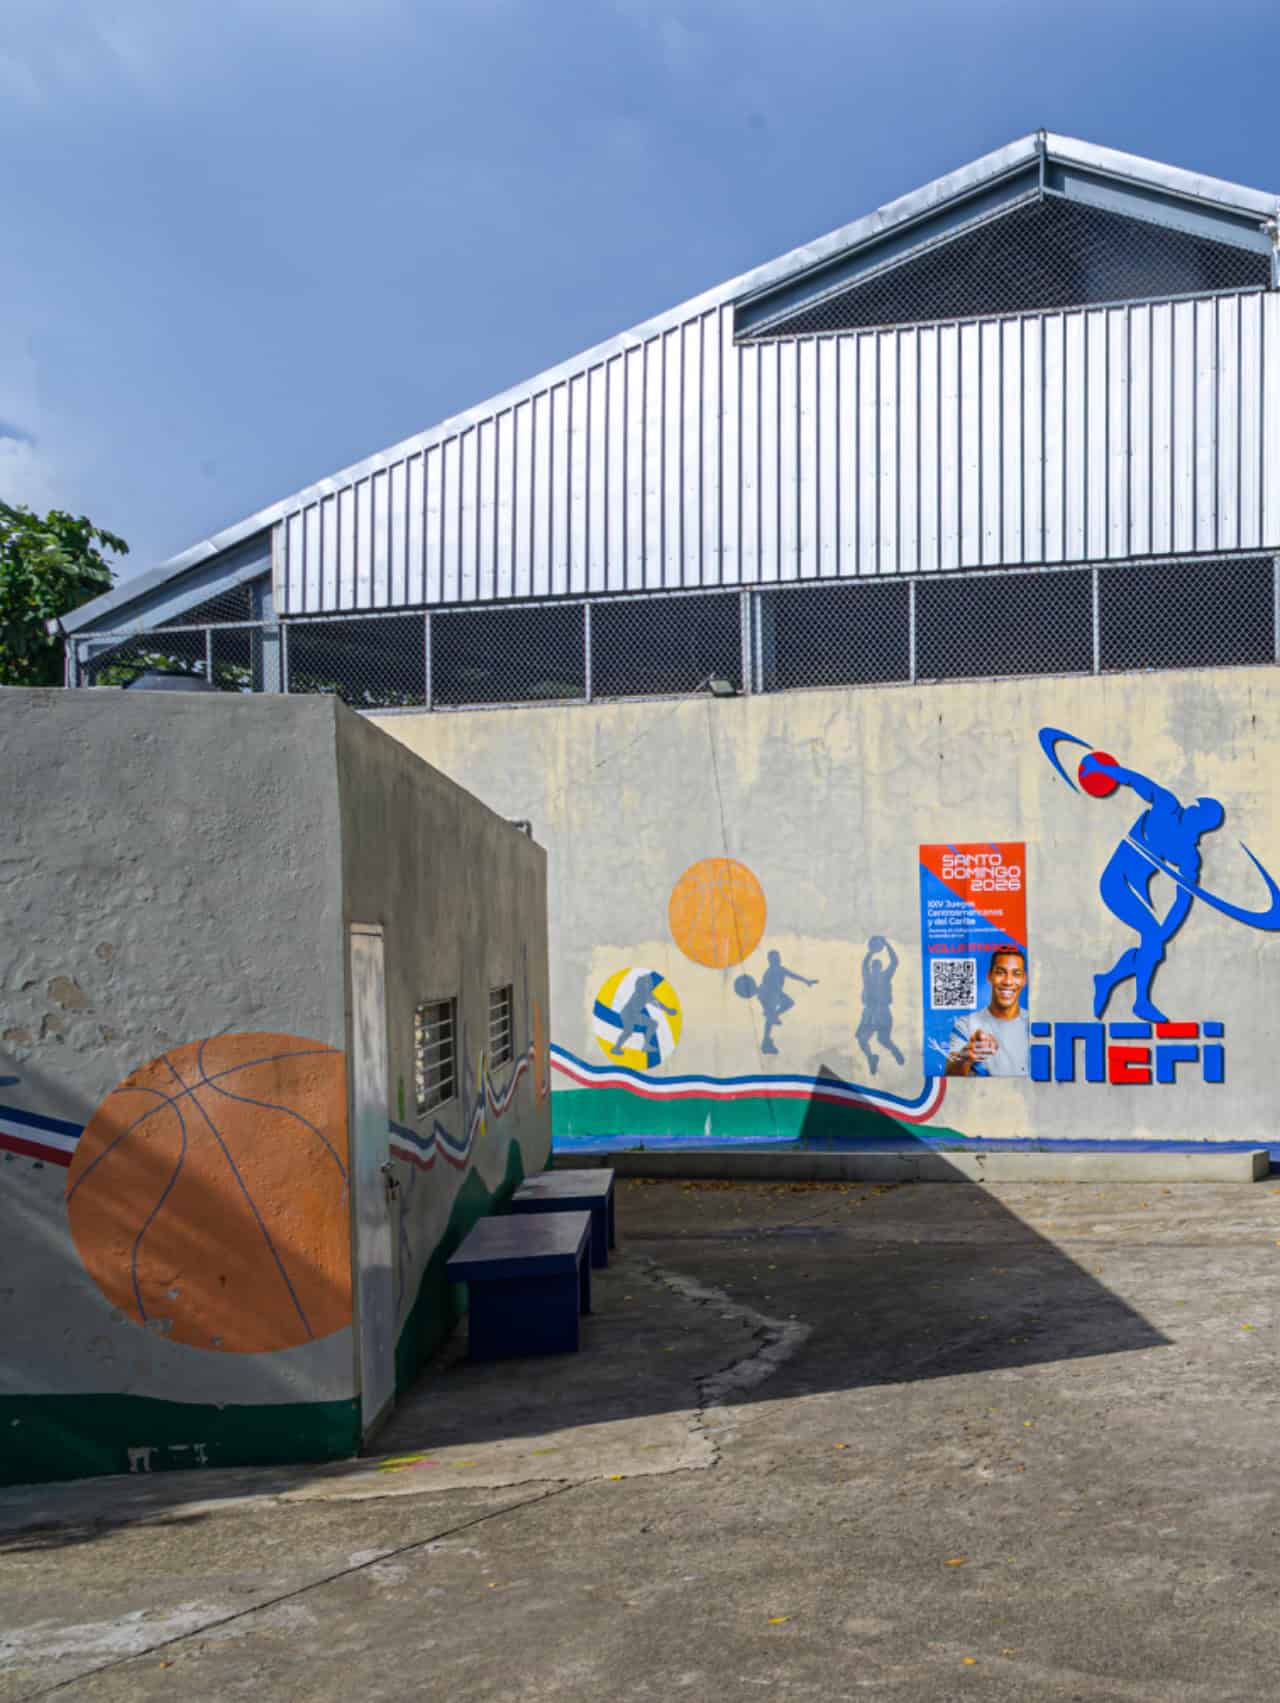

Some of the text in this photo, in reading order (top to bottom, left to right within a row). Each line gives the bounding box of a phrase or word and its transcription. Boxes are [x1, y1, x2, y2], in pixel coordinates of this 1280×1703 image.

[942, 854, 1002, 866] SANTO
[942, 866, 1021, 880] DOMINGO
[970, 879, 1021, 892] 2026
